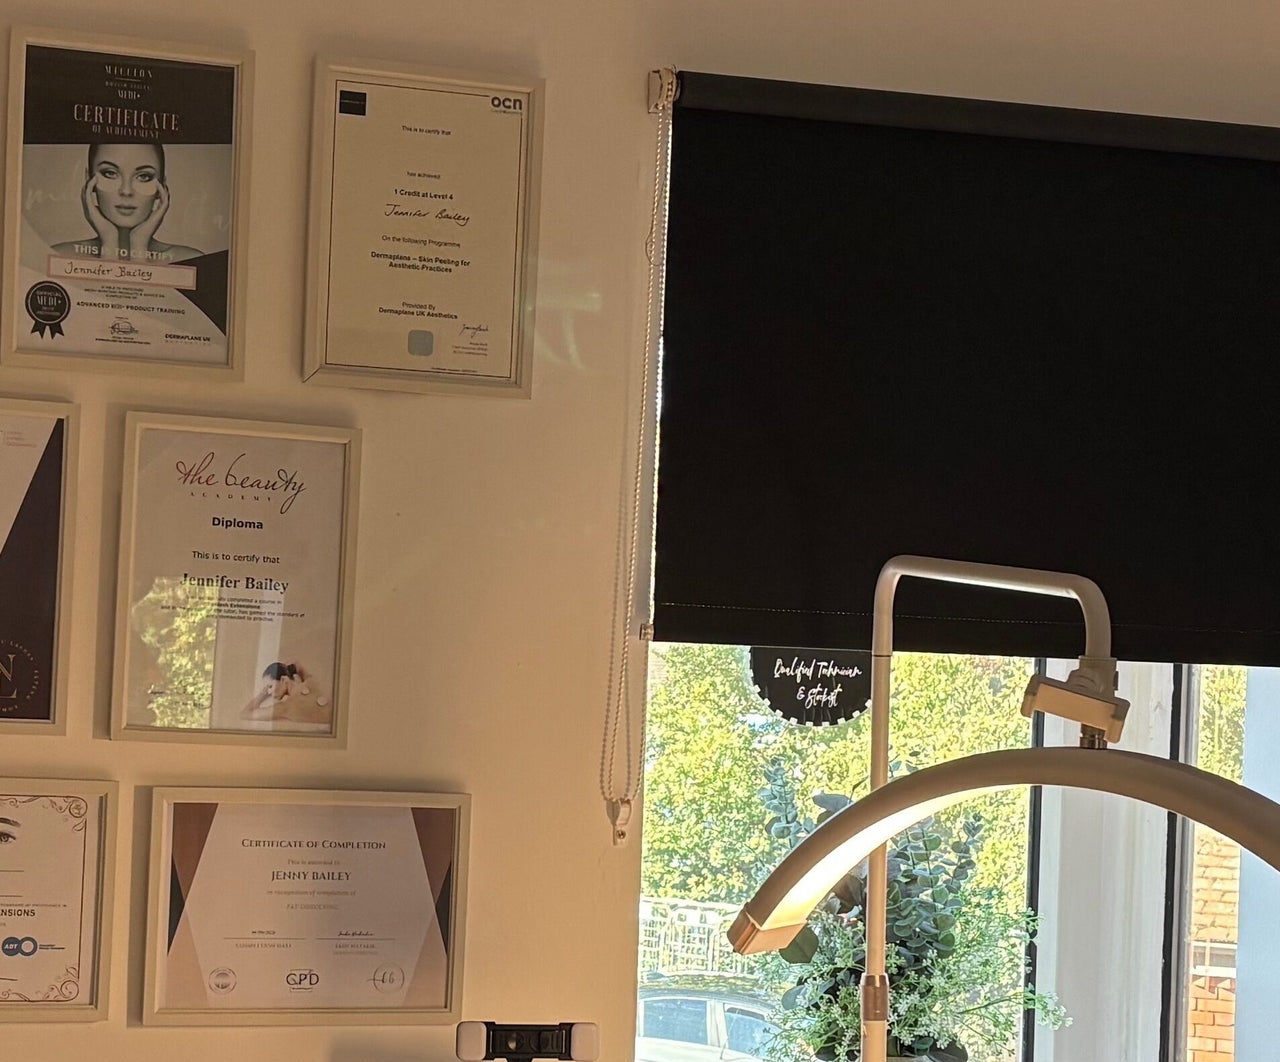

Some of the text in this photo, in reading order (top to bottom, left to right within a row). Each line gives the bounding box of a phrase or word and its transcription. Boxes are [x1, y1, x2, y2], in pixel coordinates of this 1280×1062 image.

[492, 96, 522, 110] ocn
[74, 104, 180, 131] CERTIFICATE
[399, 189, 420, 198] Credit
[430, 192, 447, 200] Level
[435, 209, 470, 226] Bailey
[74, 245, 99, 254] THIS
[371, 251, 411, 262] Dermaplane
[419, 256, 433, 264] Skin
[435, 257, 459, 267] Peeling
[65, 262, 152, 281] Jennifer Bailey
[389, 261, 452, 273] Aesthetic Practices
[379, 307, 414, 317] Dermaplane
[176, 452, 307, 514] the beauty
[212, 517, 263, 530] Diploma
[192, 551, 280, 564] This is to certify that
[180, 573, 289, 595] Jennifer Bailey
[797, 686, 805, 700] &
[242, 838, 386, 849] CERTIFICATE OF COMPLETION
[272, 871, 351, 882] JENNY BAILEY
